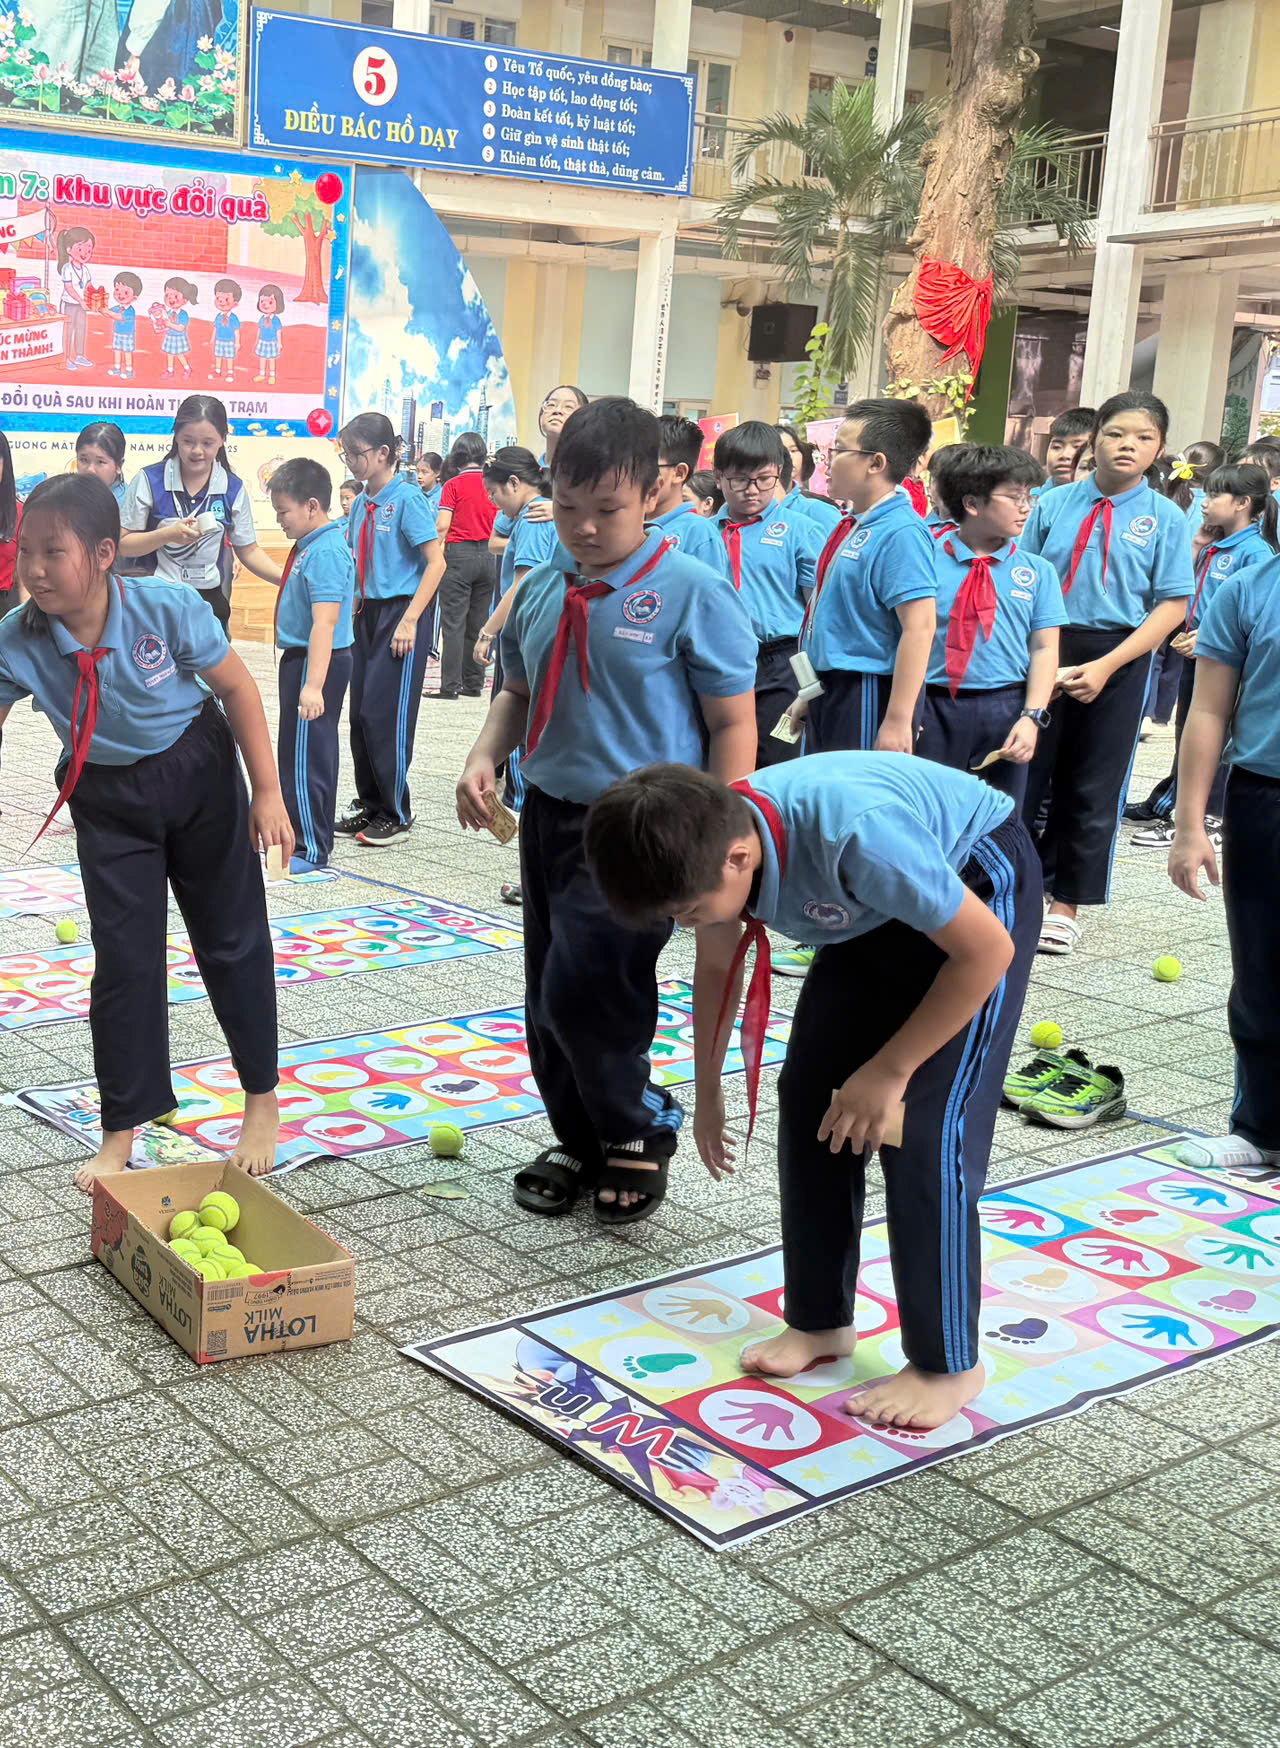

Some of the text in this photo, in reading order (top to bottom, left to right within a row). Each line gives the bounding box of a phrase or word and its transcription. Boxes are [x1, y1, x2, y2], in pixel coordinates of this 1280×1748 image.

[364, 56, 386, 96] 5
[503, 57, 525, 73] Yêu
[528, 61, 543, 77] Tổ
[545, 65, 575, 84] quốc,
[578, 71, 598, 85] yêu
[601, 72, 628, 92] đồng
[630, 77, 653, 95] bào;
[502, 81, 525, 99] Học
[528, 85, 547, 103] tập
[549, 87, 568, 105] tốt,
[570, 90, 587, 105] lao
[590, 93, 617, 113] động
[619, 97, 638, 115] tốt;
[284, 101, 459, 152] ĐIỀU BÁC HỒ DẠY
[501, 103, 531, 121] Đoàn
[534, 105, 552, 123] kết
[555, 109, 574, 129] tốt,
[576, 113, 591, 131] kỷ
[593, 116, 615, 133] luật
[617, 118, 636, 136] tốt;
[500, 126, 522, 142] Giữ
[524, 130, 542, 147] gìn
[545, 134, 557, 149] vệ
[560, 135, 584, 151] sinh
[587, 138, 609, 155] thật
[611, 141, 630, 158] tốt;
[499, 149, 537, 167] Khiêm
[539, 153, 561, 172] tốn,
[563, 157, 586, 173] thật
[589, 160, 610, 177] thà,
[612, 163, 639, 182] dũng
[641, 166, 665, 182] cảm.
[22, 172, 49, 199] 7:
[55, 176, 110, 206] Khu
[117, 186, 167, 215] vực
[172, 178, 213, 216] đổi
[220, 192, 268, 223] quà
[11, 342, 53, 359] THÀNH!
[14, 329, 48, 344] MỪNG
[1, 385, 28, 407] ĐỔI
[32, 389, 62, 410] QUÀ
[66, 395, 95, 408] SAU
[98, 396, 122, 410] KHI
[126, 393, 165, 411] HOÀN
[229, 401, 267, 415] TRẠM
[159, 1286, 192, 1335] LOTHA
[245, 1306, 282, 1325] MILK
[244, 1315, 316, 1344] LOTHA
